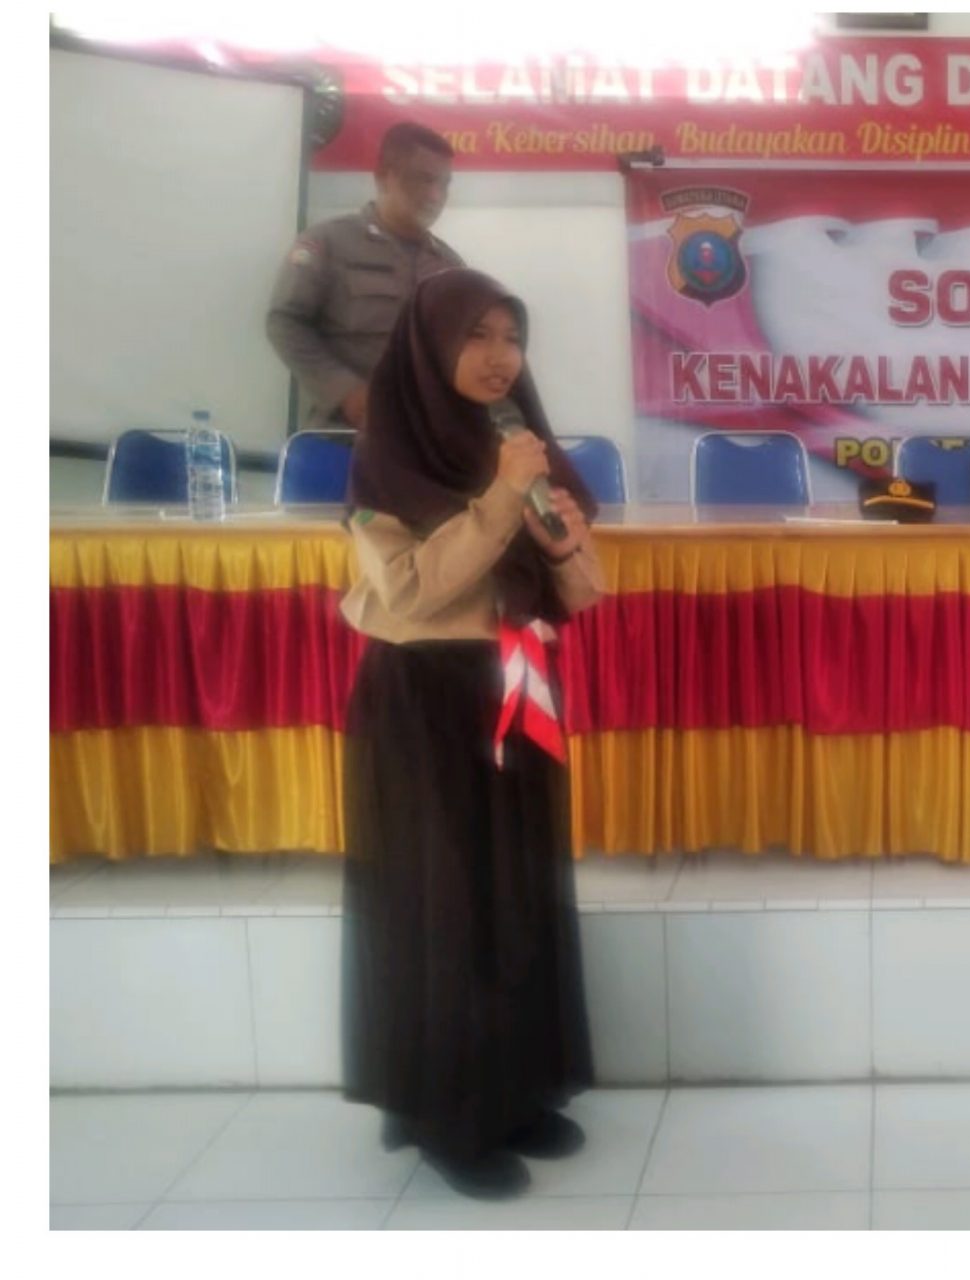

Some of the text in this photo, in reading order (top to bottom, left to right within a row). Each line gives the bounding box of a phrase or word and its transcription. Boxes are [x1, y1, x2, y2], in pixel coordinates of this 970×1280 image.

[382, 58, 659, 105] SELAMAT
[684, 54, 923, 107] DATANG
[675, 123, 847, 160] Budayakan
[671, 353, 969, 403] KENAKALAN
